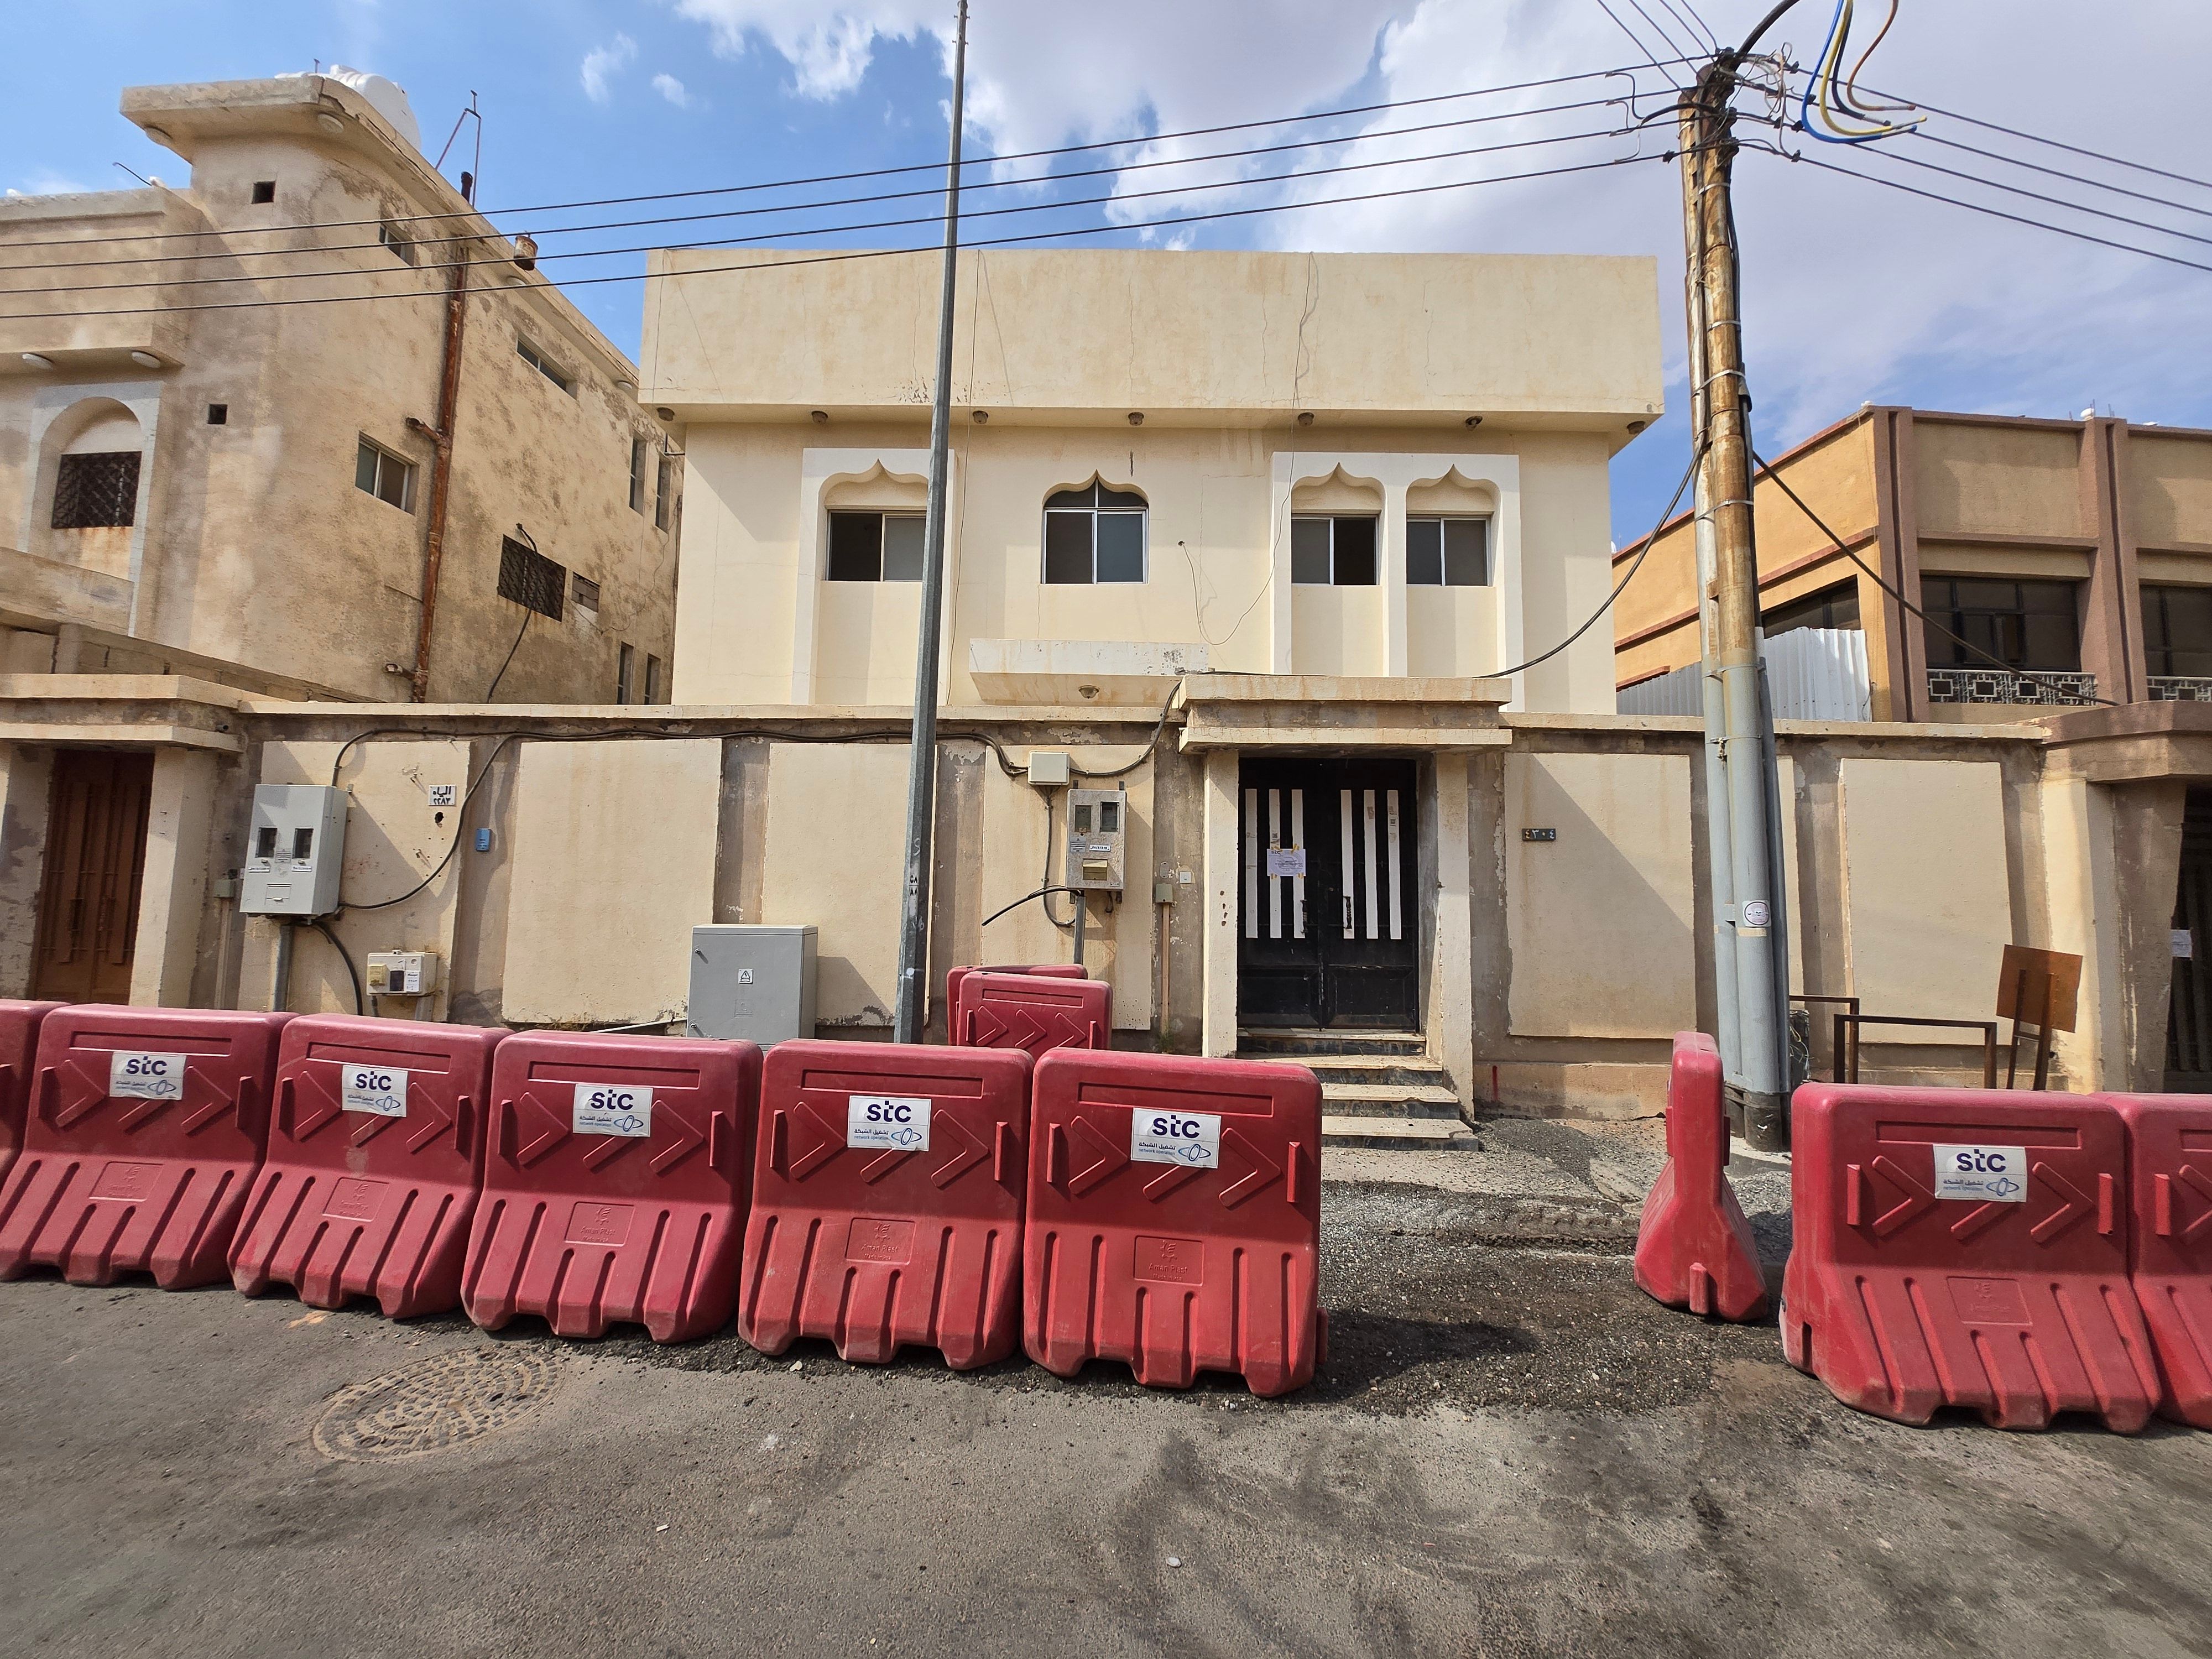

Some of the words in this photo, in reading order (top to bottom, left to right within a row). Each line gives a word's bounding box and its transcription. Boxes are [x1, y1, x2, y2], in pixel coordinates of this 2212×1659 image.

[1525, 830, 1554, 839] ٤٣٠٤
[126, 1056, 168, 1076] stc
[356, 1071, 392, 1091] stc
[590, 1089, 634, 1110] stc
[867, 1100, 912, 1123] stc
[1152, 1114, 1200, 1139] stc
[1957, 1149, 2006, 1172] stc
